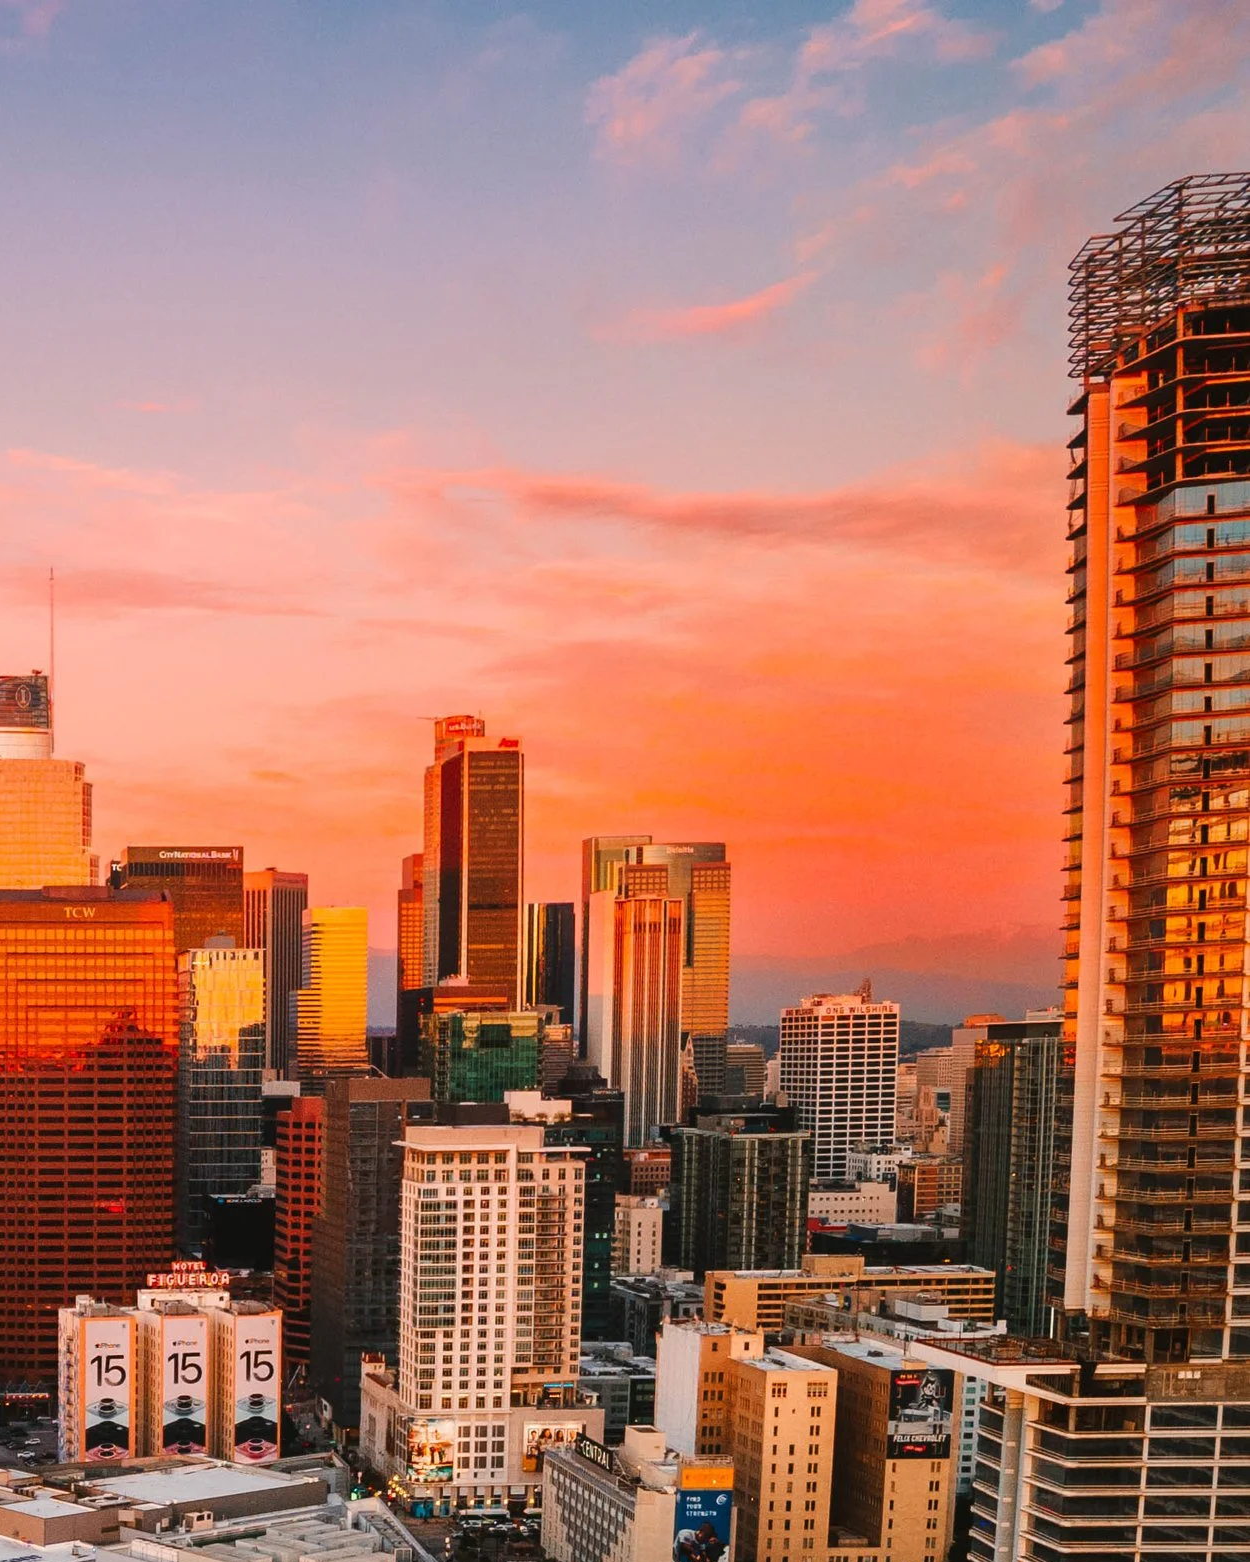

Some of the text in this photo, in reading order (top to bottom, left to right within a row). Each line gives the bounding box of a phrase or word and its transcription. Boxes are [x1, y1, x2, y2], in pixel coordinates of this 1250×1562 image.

[63, 906, 96, 918] TCW
[826, 1005, 894, 1015] ONE WILSHIRE
[172, 1261, 206, 1270] HOTEL
[148, 1273, 230, 1286] FIGUEROA
[90, 1354, 127, 1387] 15
[167, 1352, 203, 1385] 15
[239, 1350, 275, 1382] 15
[893, 1434, 910, 1443] FELIX
